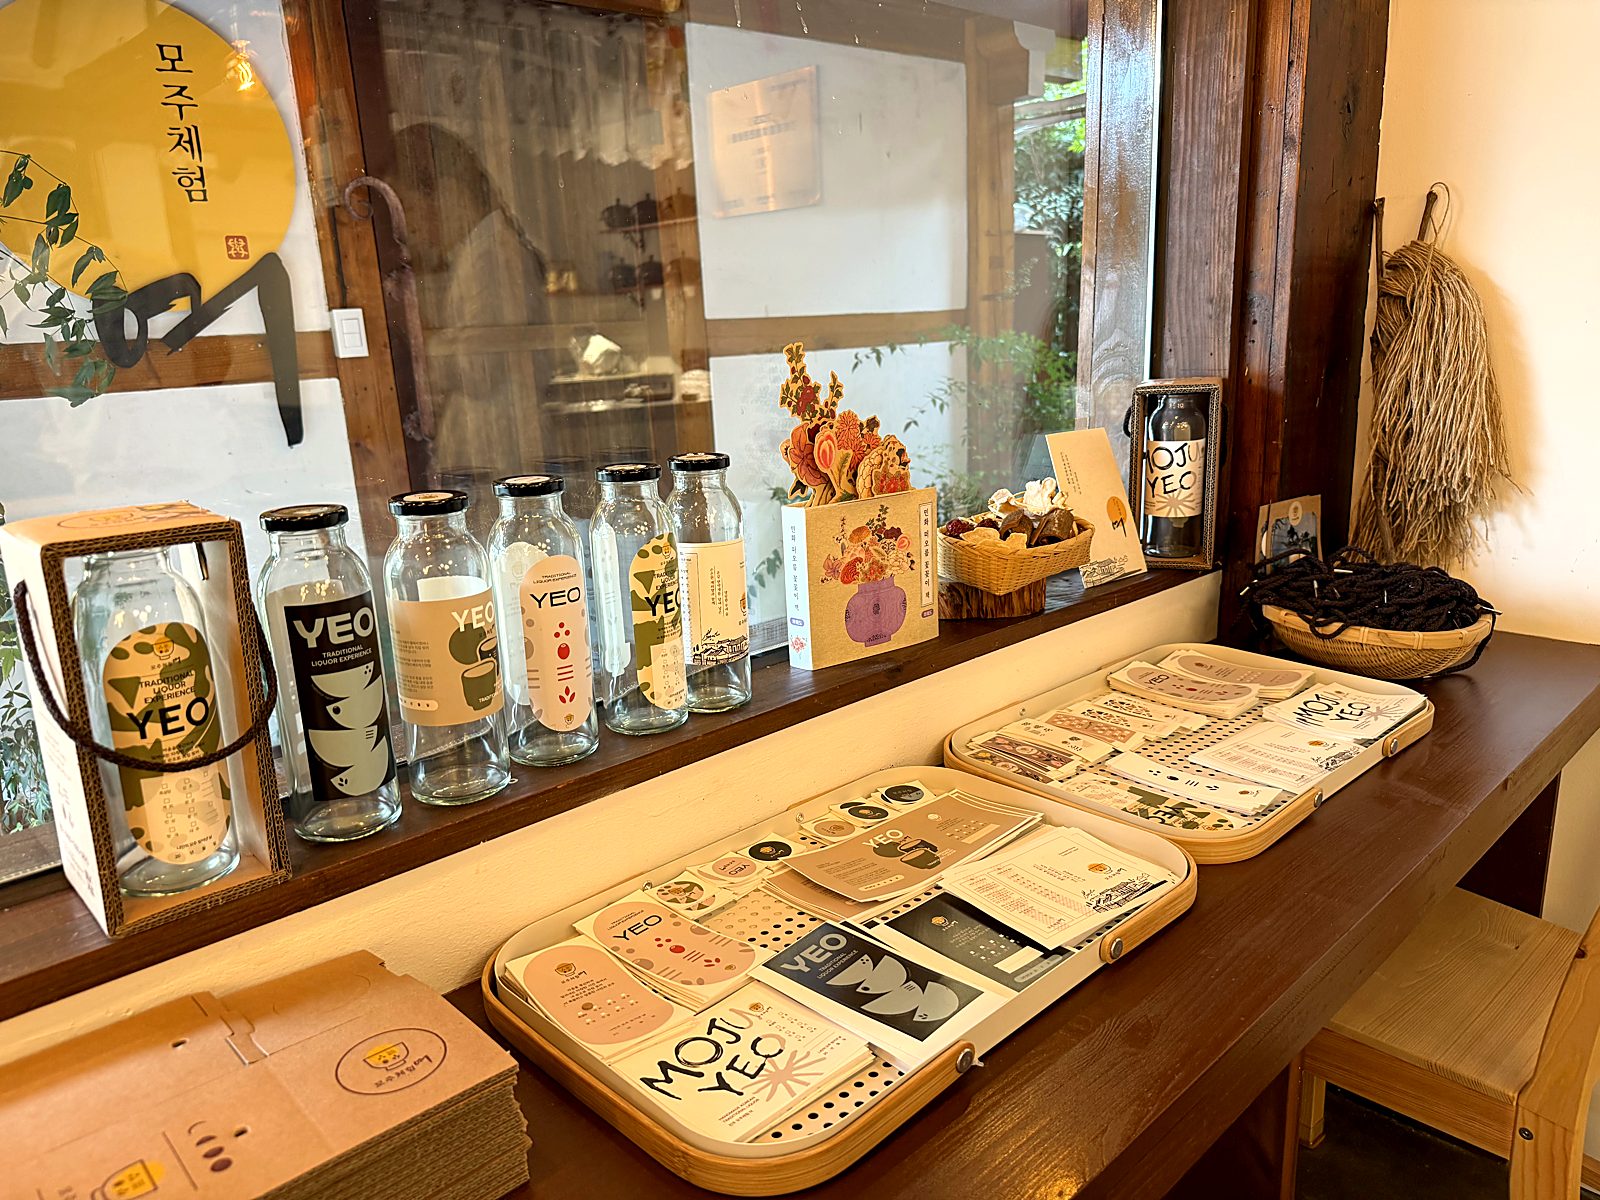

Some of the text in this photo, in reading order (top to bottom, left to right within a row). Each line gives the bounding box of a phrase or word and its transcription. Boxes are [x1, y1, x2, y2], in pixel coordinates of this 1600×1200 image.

[155, 43, 209, 204] 모주체험
[1146, 470, 1197, 498] YEO
[529, 586, 581, 609] YEO
[292, 606, 374, 649] YEO
[450, 600, 494, 633] YEO
[311, 647, 373, 667] LIQUOR EXPERIENCE
[321, 644, 364, 659] TRADITIONAL
[139, 669, 195, 688] TRADITIONAL
[153, 681, 187, 695] LIQUOR
[144, 686, 197, 704] EXPERIENCE
[126, 696, 210, 740] YEO
[1329, 701, 1371, 722] YEO
[861, 829, 904, 849] YEO
[612, 914, 663, 941] YEO
[780, 933, 848, 973] YEO
[639, 1007, 763, 1100] MOJU
[697, 1033, 787, 1097] YEO
